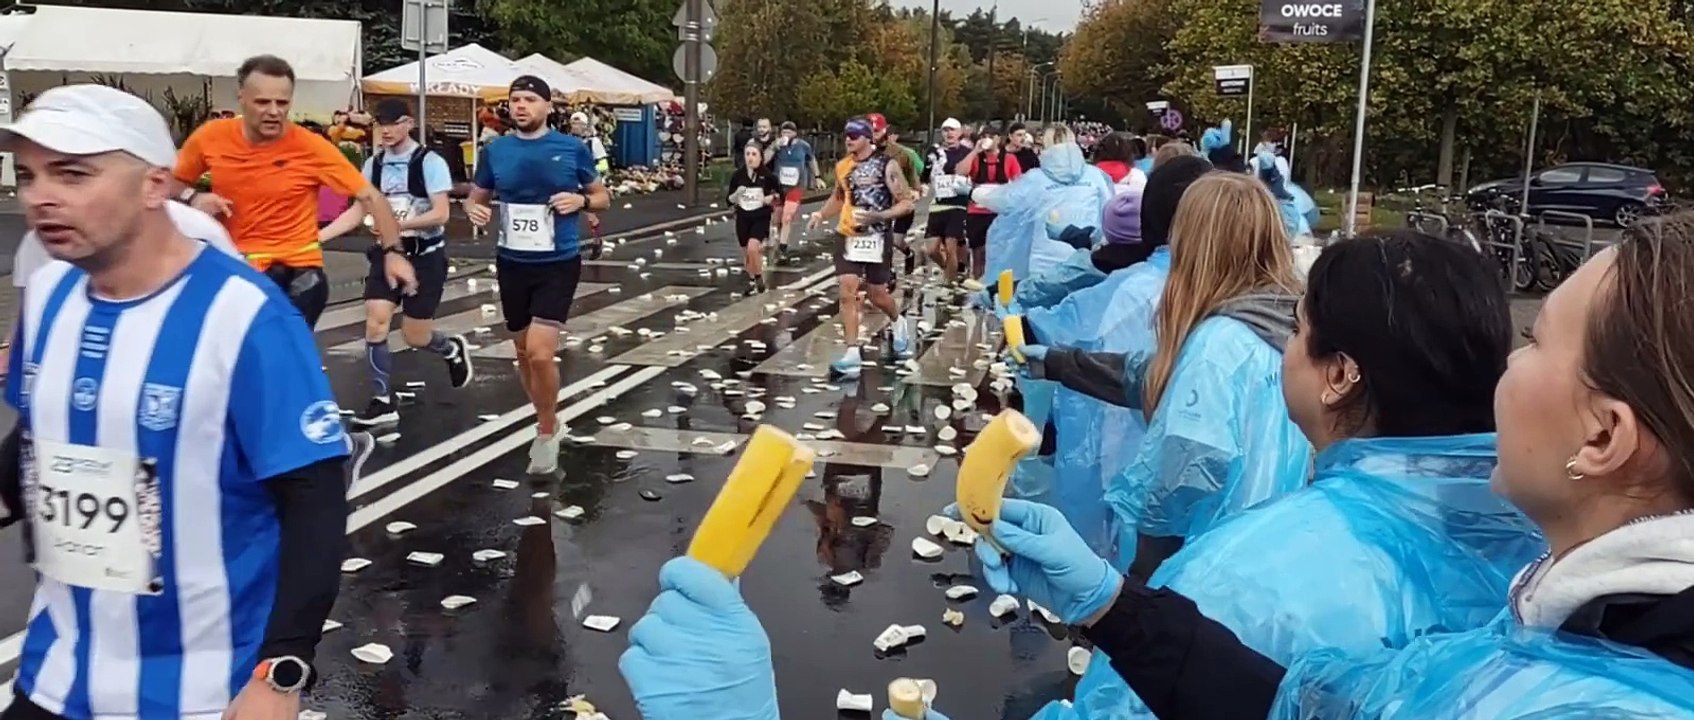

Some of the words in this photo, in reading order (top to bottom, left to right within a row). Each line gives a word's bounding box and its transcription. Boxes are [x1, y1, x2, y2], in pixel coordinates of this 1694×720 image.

[1281, 4, 1343, 17] OWOCE
[1293, 22, 1328, 36] fruits
[512, 219, 539, 232] 578
[854, 240, 877, 249] 2321
[39, 485, 129, 534] 3199
